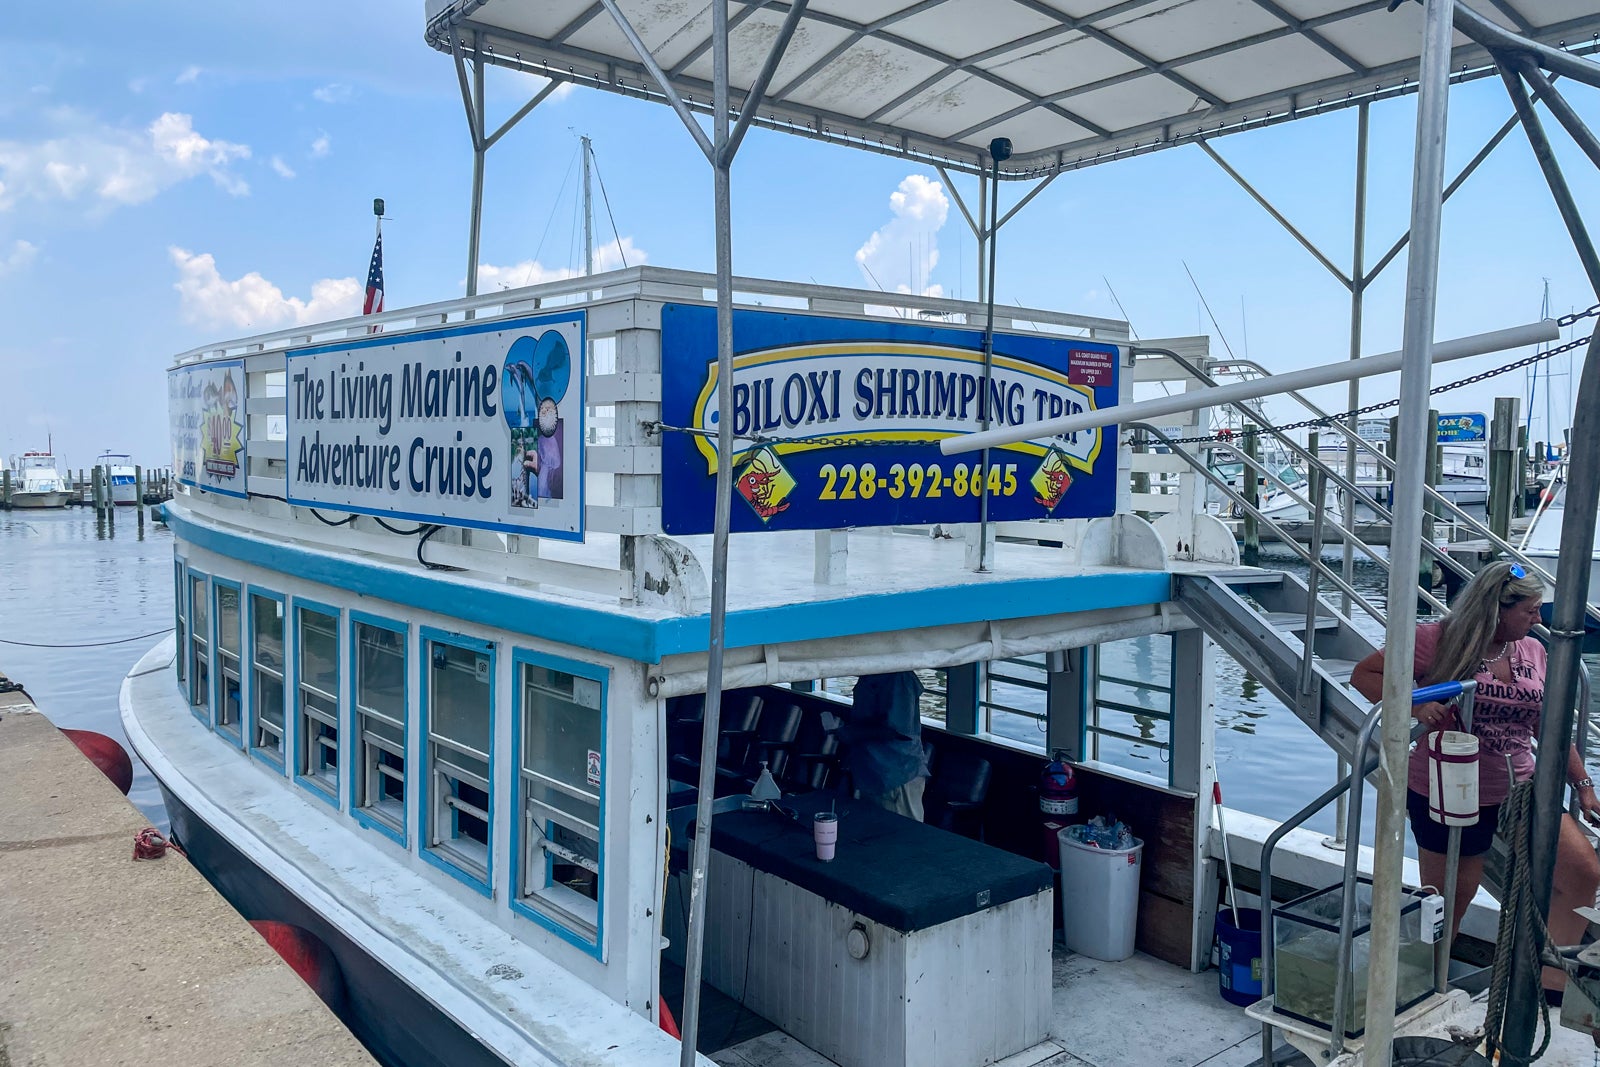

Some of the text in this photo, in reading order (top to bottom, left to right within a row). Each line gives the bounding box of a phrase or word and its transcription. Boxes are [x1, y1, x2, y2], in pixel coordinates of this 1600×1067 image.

[293, 351, 498, 436] The Living Marine
[733, 366, 1083, 446] BILOXI SHRIMPING TRIP
[297, 430, 493, 499] Adventure Cruise
[818, 463, 1018, 499] 228-392-8645
[1476, 681, 1543, 703] ennesse
